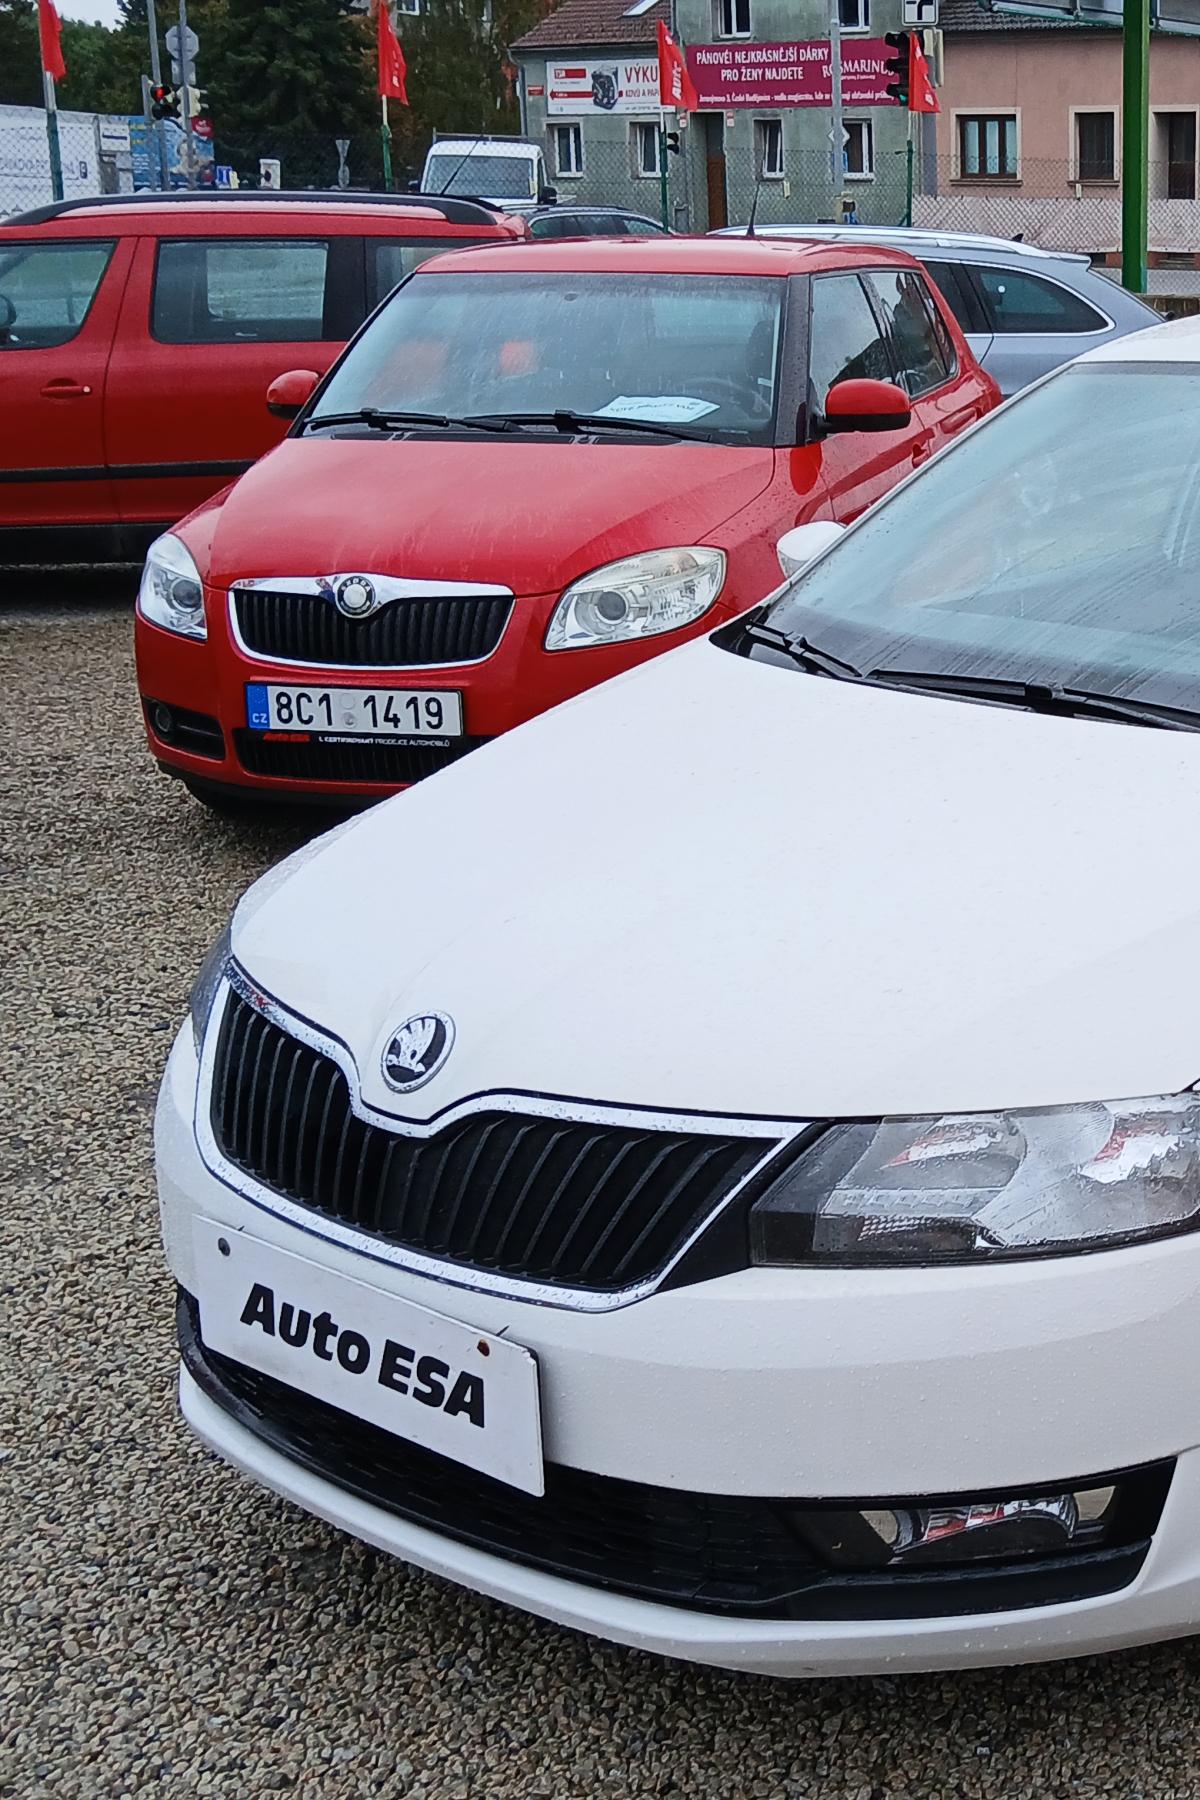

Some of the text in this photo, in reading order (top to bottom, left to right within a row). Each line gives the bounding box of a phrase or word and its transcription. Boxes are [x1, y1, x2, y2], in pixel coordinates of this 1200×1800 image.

[735, 46, 797, 64] NEJKRÁSNĚJŠÍ
[799, 45, 829, 61] DÁRKY
[624, 62, 658, 83] VÝKU
[721, 66, 804, 81] PRO ŽENY NAJDETE
[252, 713, 268, 724] CZ
[275, 691, 443, 730] 8C1 1419
[239, 1282, 485, 1429] Auto ESA
